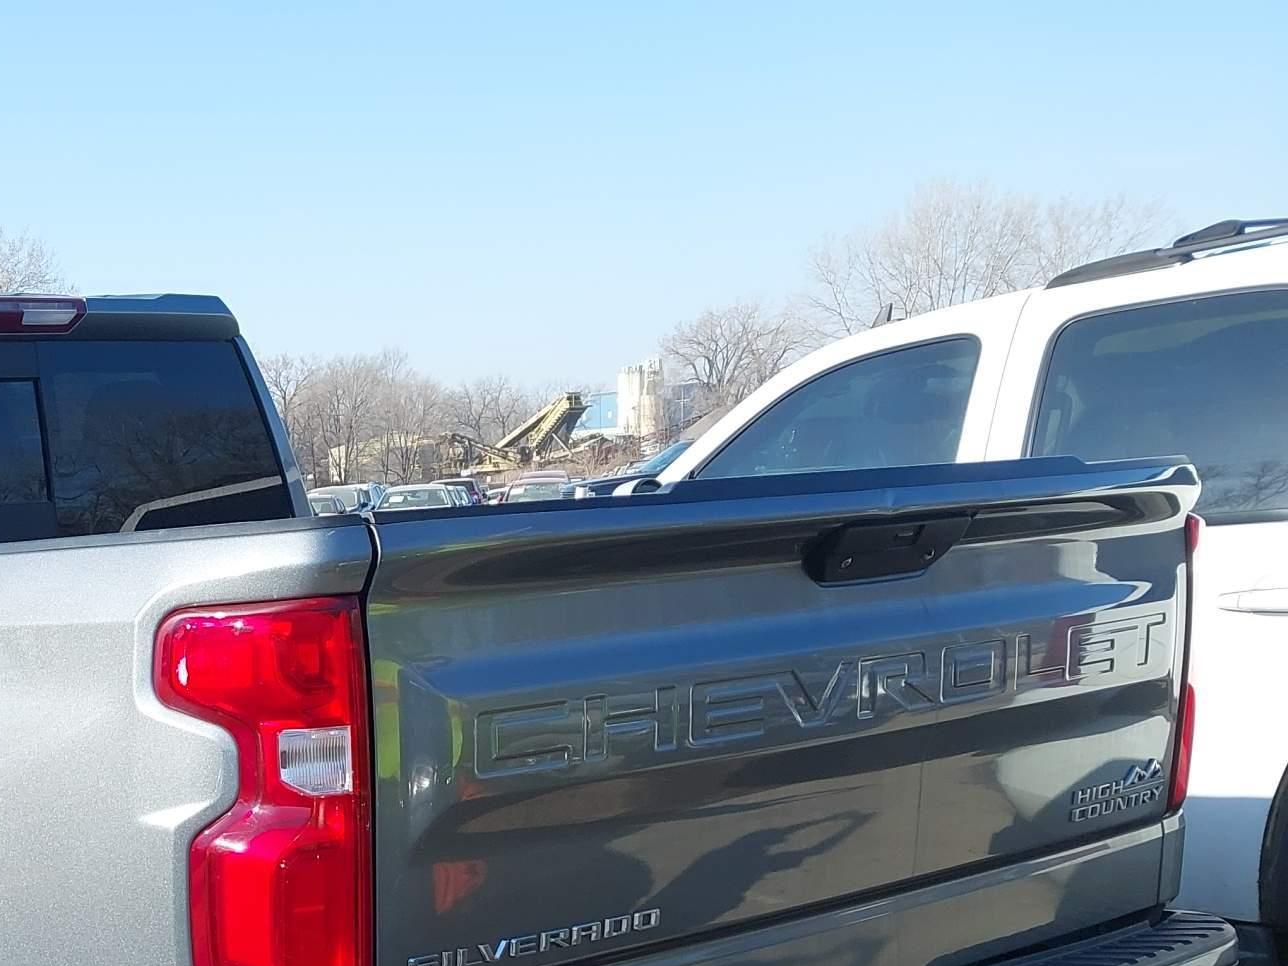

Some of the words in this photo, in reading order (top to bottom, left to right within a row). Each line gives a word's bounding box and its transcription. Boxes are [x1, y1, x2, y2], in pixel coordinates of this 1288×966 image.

[473, 611, 1167, 779] CHEVROLET
[1070, 785, 1164, 822] COUNTRY
[1073, 779, 1124, 805] HIGH
